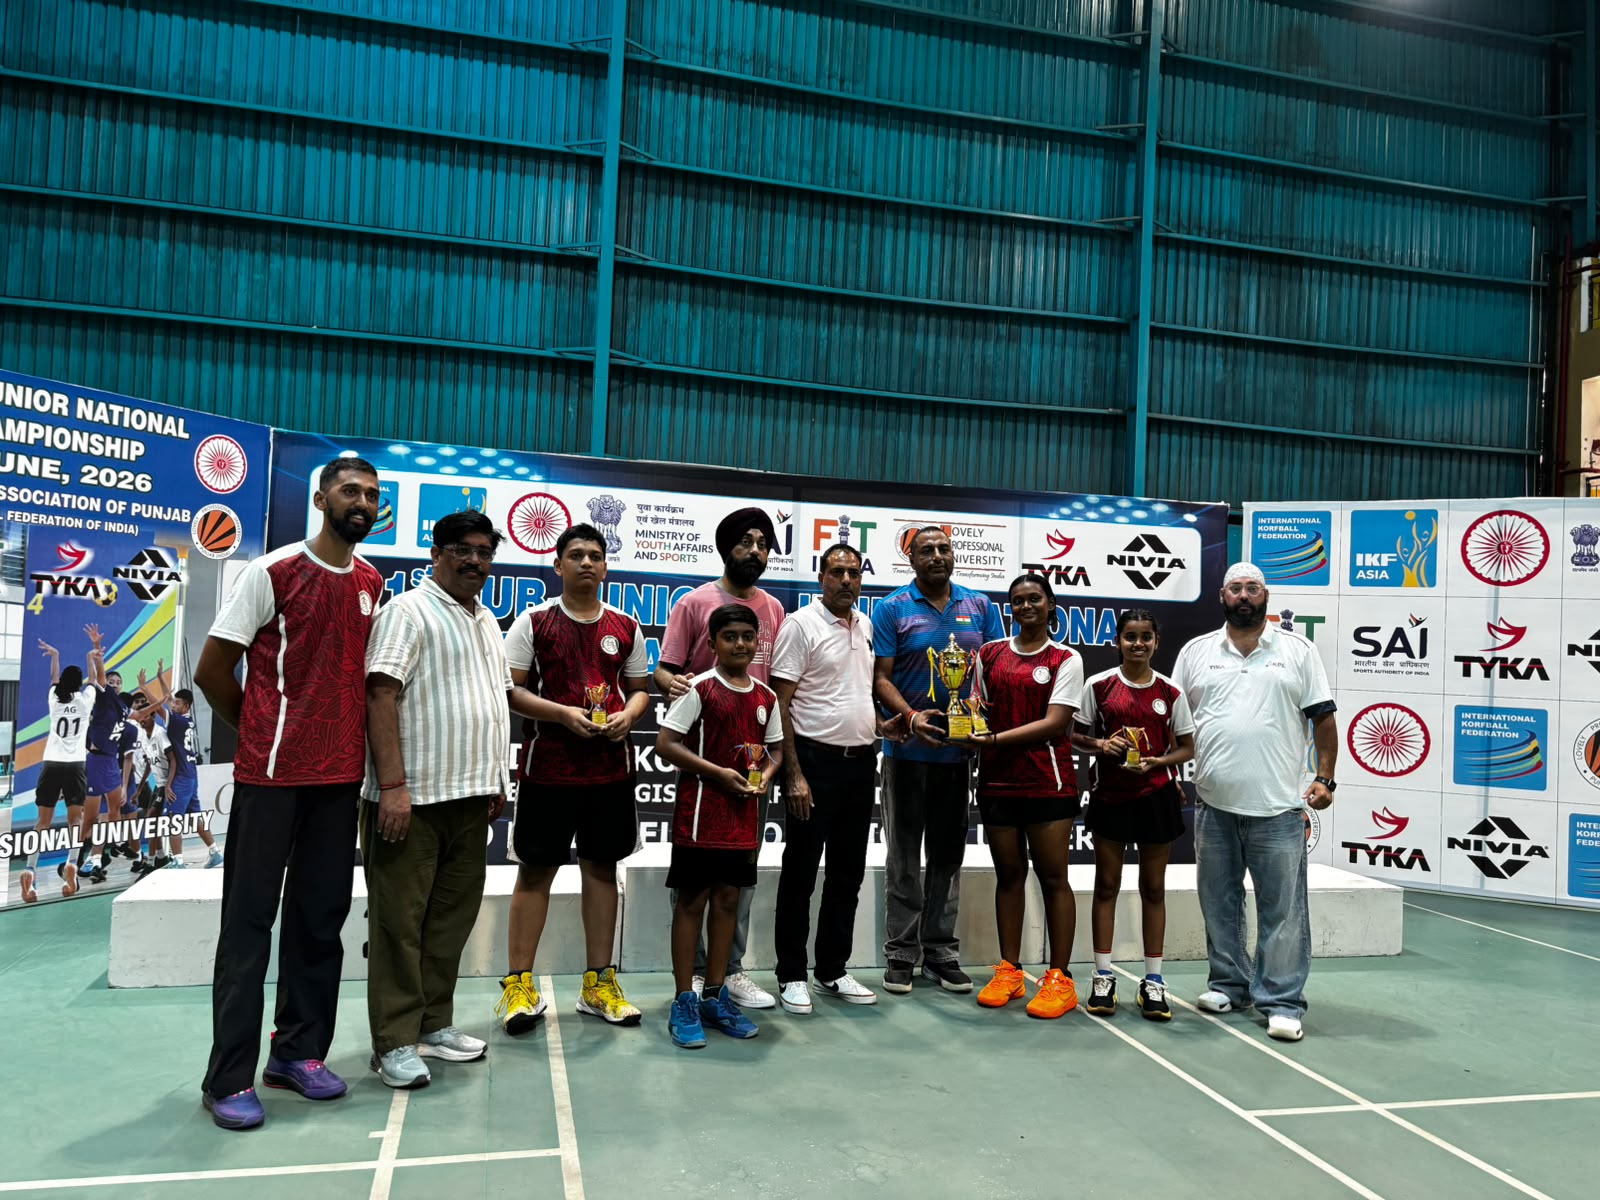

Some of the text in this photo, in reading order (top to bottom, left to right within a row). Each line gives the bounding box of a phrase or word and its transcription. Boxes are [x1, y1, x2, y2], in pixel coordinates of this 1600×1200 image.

[0, 382, 190, 440] NIOR NATIONAL
[80, 464, 153, 493] 2026
[106, 498, 126, 515] OF
[131, 502, 191, 523] PUNJAB
[636, 503, 685, 514] युवा कार्यक्रम
[7, 510, 82, 529] FEDERATION
[86, 519, 101, 531] OF
[104, 521, 139, 537] INDIA)
[636, 515, 695, 527] एवं खेल मंत्रालय
[1257, 517, 1322, 525] INTERNATIONAL
[635, 529, 701, 542] MINISTRY OF
[944, 526, 984, 538] OVELY
[635, 540, 714, 553] YOUTH AFFAIRS
[951, 540, 1005, 552] ROFESSIONAL
[634, 551, 698, 563] AND SPORTS
[953, 554, 1005, 566] NIVERSITY
[1107, 554, 1187, 569] NIVIA
[1355, 552, 1398, 567] IKF
[112, 567, 182, 583] NIVIA
[1355, 570, 1390, 580] ASIA
[30, 574, 101, 599] TYKA
[1351, 626, 1428, 659] SAI
[1454, 655, 1551, 681] TYKA
[1461, 712, 1537, 723] INTERNATIONAL
[56, 716, 81, 739] 01
[1461, 721, 1510, 730] KORFBALL
[1461, 729, 1520, 739] FEDERATION
[1576, 735, 1587, 761] LOVELY
[1576, 821, 1600, 830] INTE
[0, 810, 214, 859] SIONAL UNIVERSITY
[1447, 837, 1551, 859] NIVIA
[1341, 841, 1432, 872] TYKA
